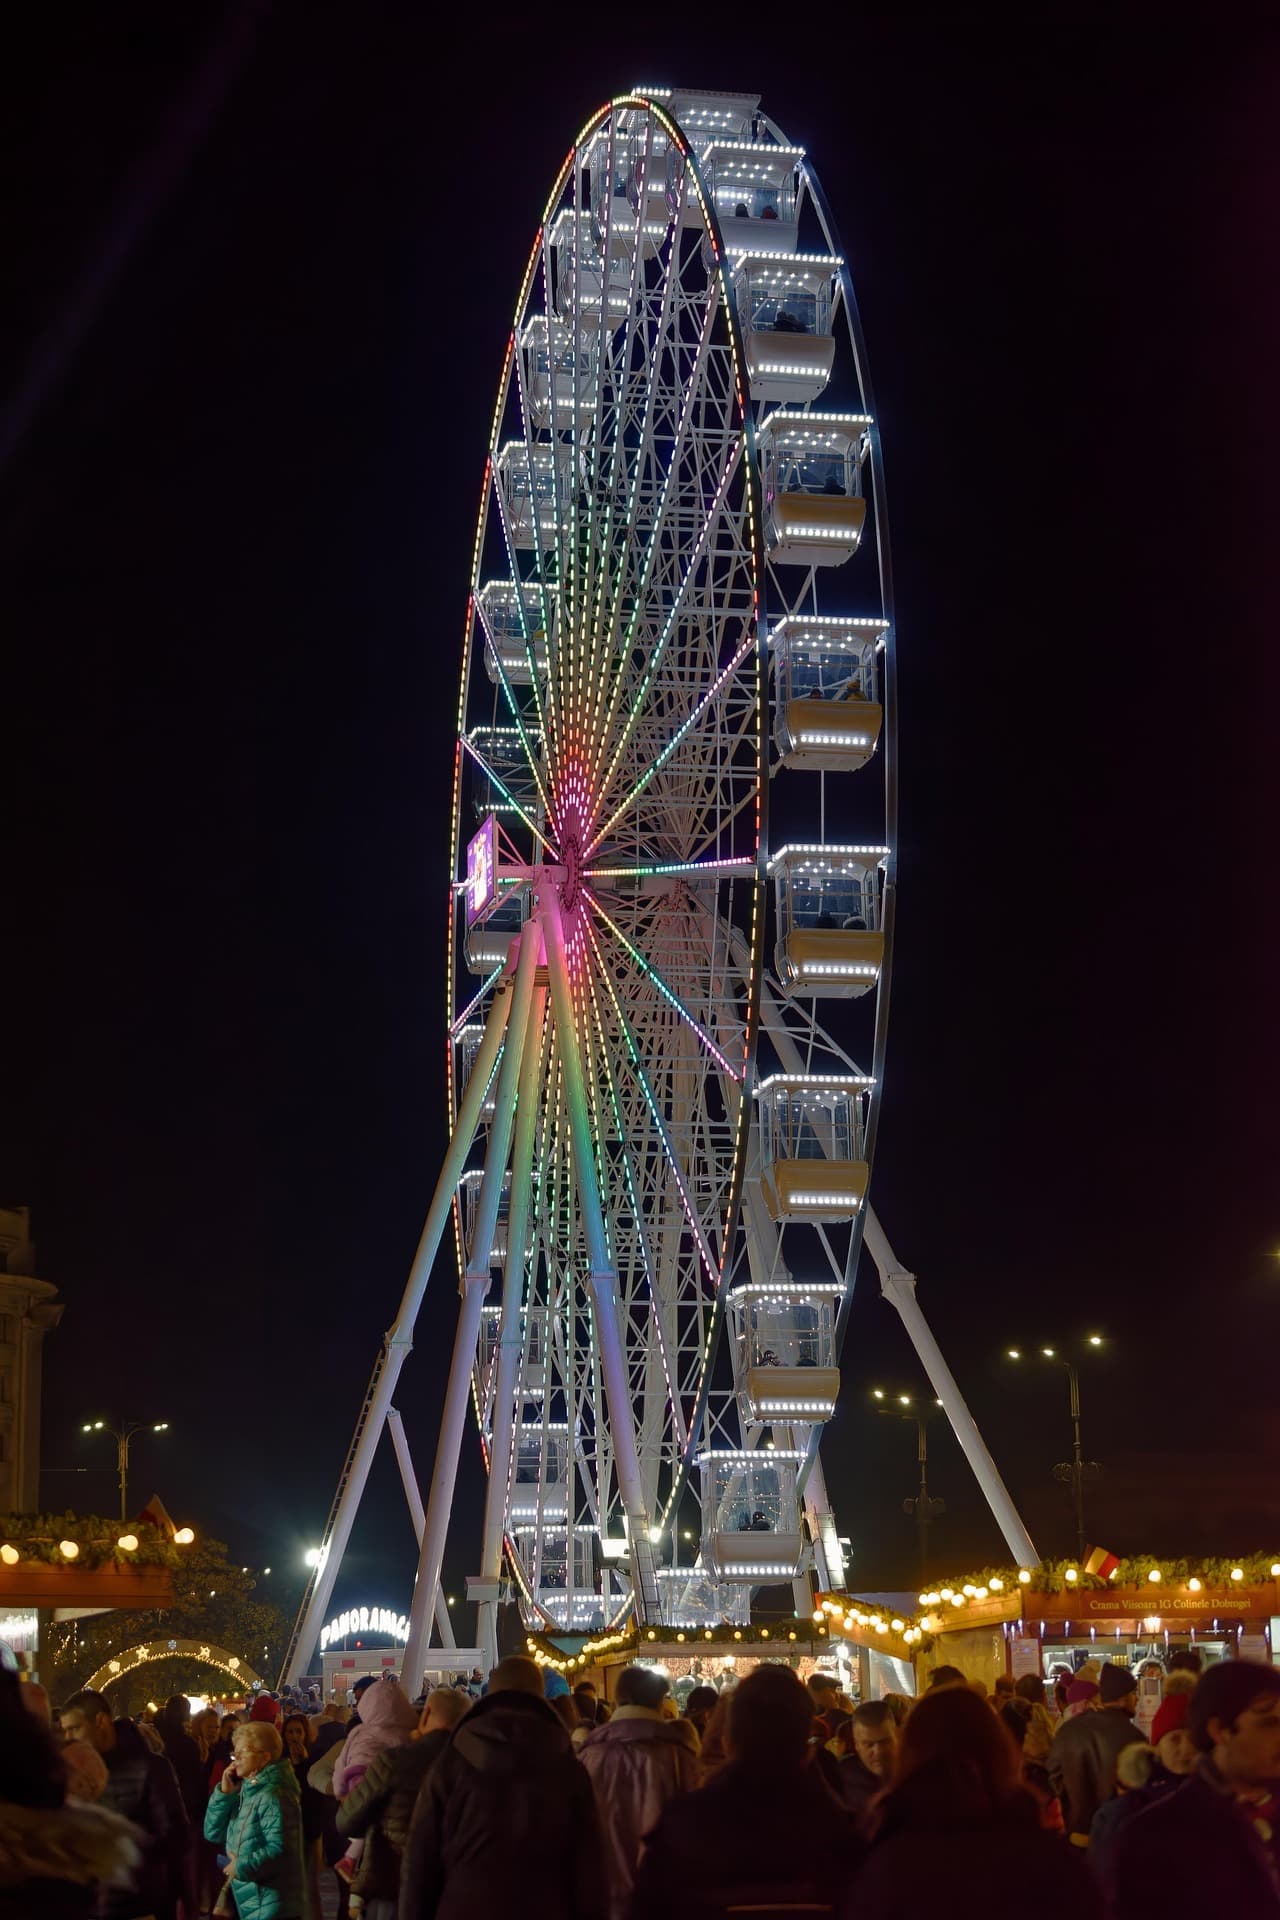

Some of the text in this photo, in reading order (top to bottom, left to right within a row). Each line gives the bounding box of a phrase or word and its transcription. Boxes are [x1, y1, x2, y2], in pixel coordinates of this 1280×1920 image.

[1089, 1600, 1119, 1609] Crama
[1173, 1599, 1209, 1608] Colinele
[1211, 1598, 1251, 1610] Dobrogei
